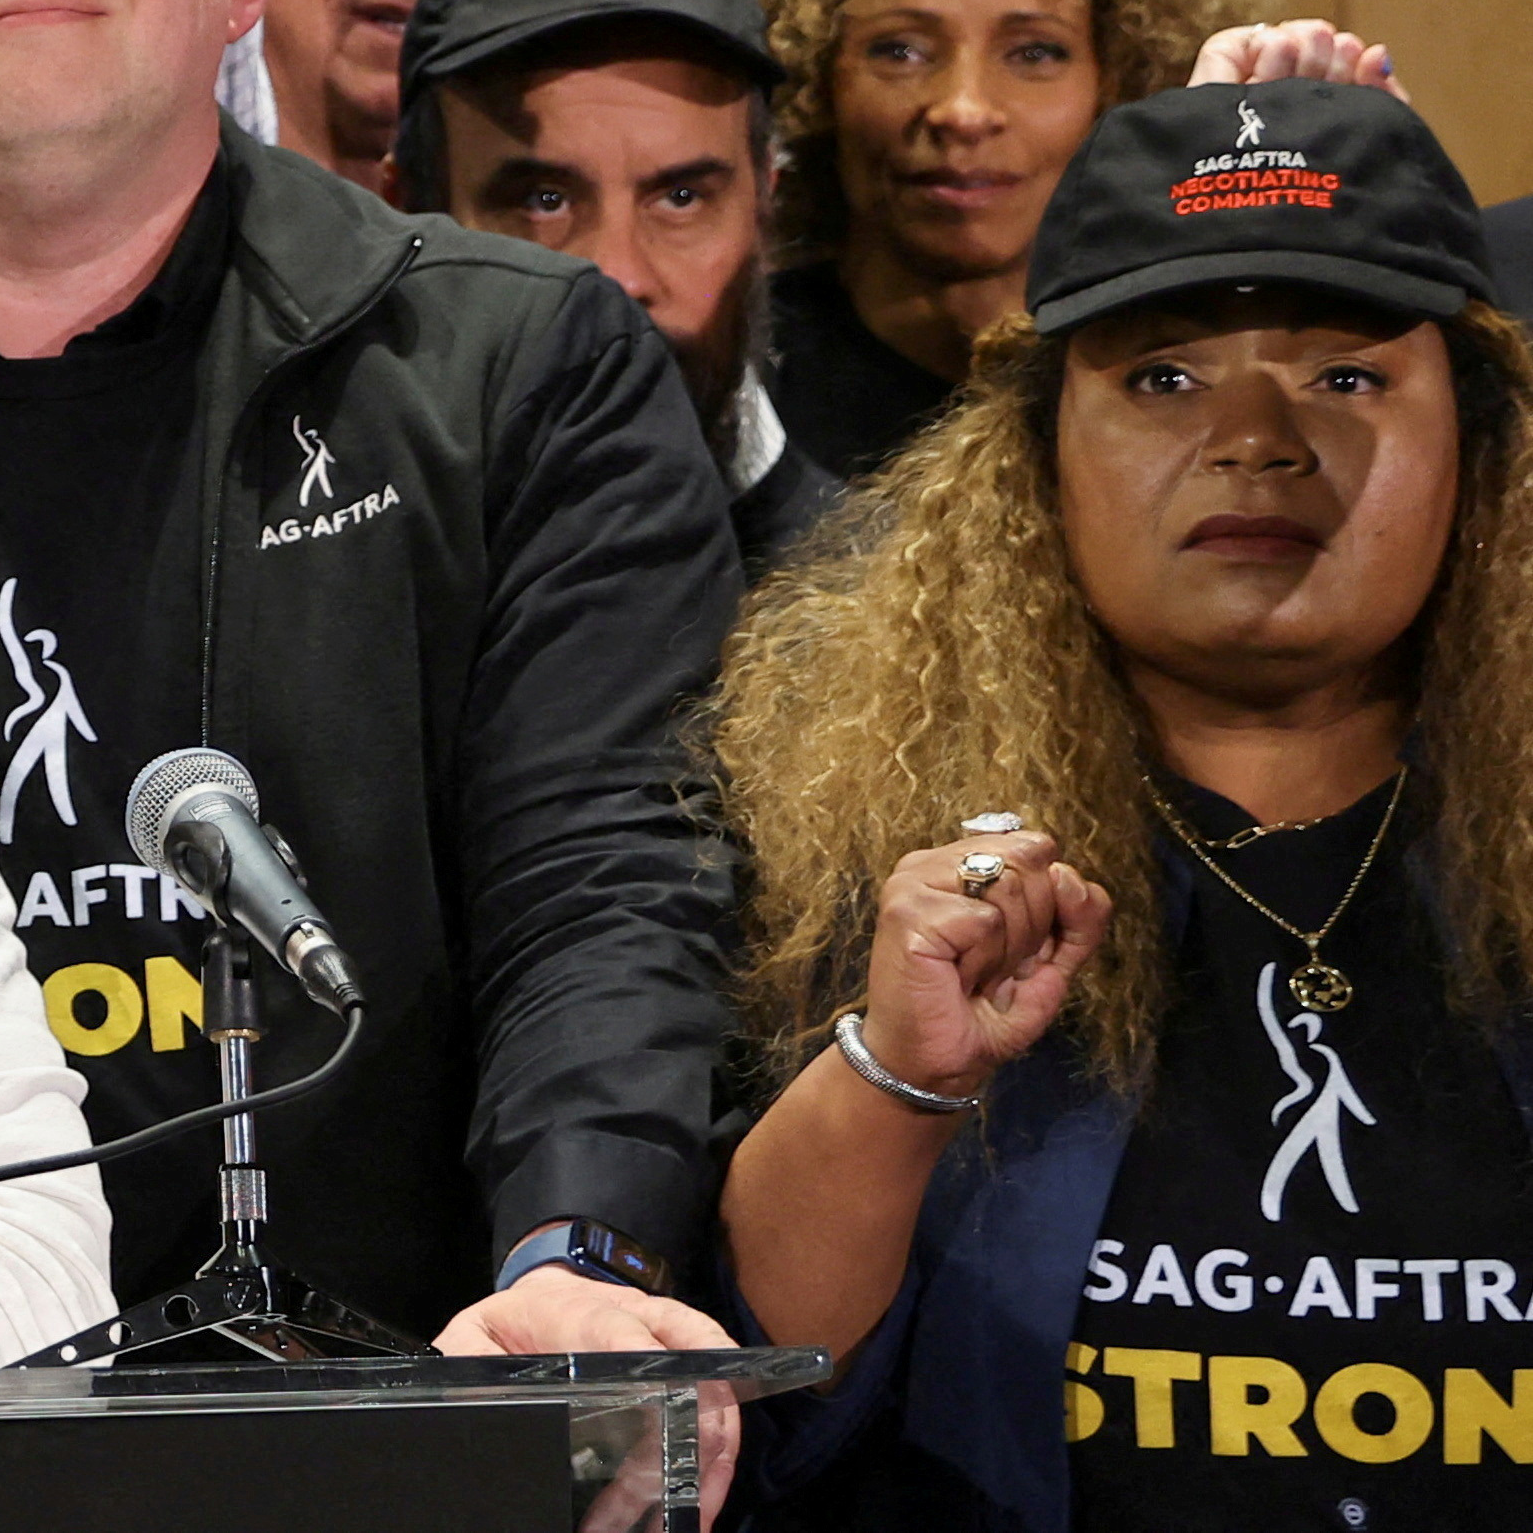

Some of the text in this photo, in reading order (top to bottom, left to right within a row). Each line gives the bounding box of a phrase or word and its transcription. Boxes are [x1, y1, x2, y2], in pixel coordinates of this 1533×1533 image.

[1169, 168, 1342, 200] NEGOTIATING
[1174, 188, 1334, 216] COMMITTEE
[255, 483, 401, 551] AG·AFTRA
[1082, 1238, 1533, 1323] SAG·AFTR
